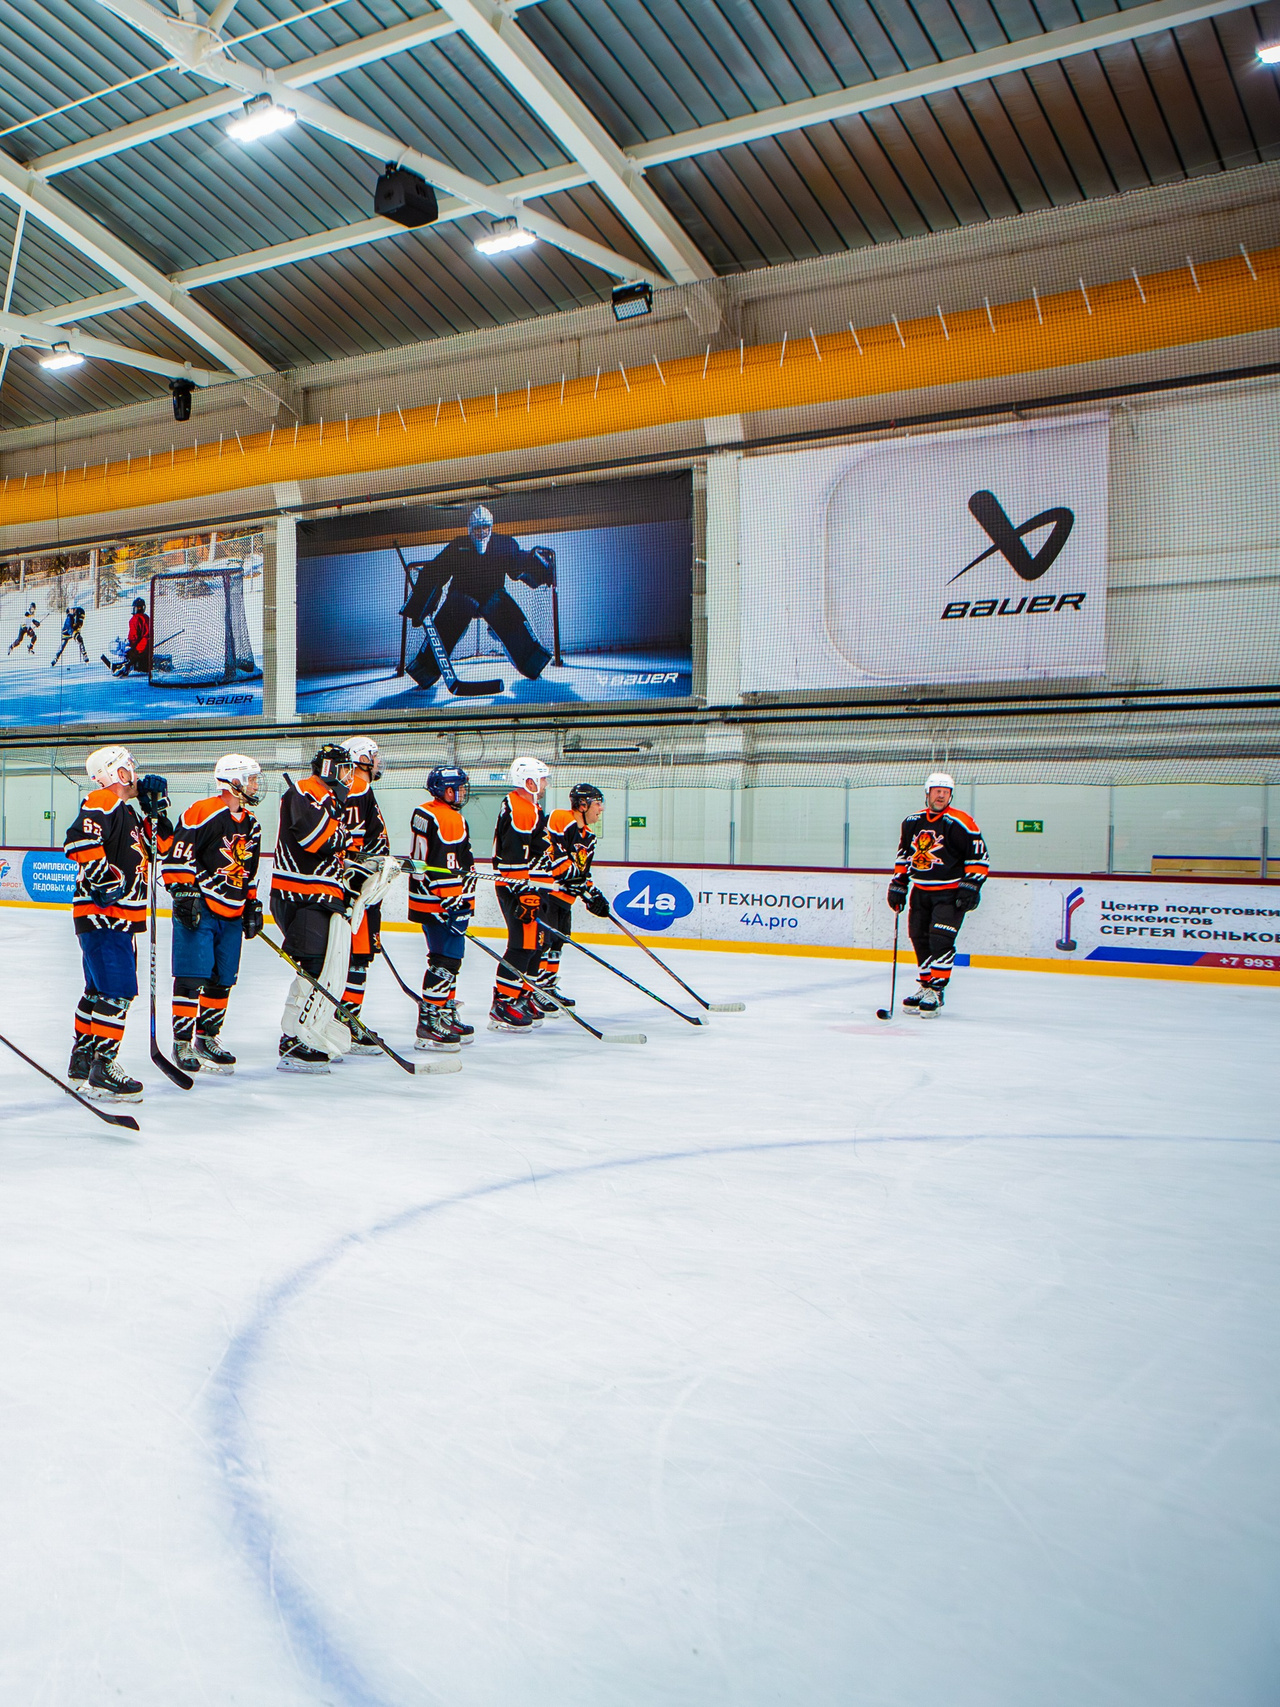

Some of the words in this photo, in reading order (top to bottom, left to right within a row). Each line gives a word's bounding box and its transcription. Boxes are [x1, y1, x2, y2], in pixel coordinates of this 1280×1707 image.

[941, 592, 1087, 620] BAUER
[427, 627, 454, 680] BAUER
[610, 672, 679, 686] BAUER
[206, 695, 254, 706] BAUER
[345, 806, 359, 825] 71
[173, 841, 194, 861] 64
[718, 892, 844, 910] ТЕХНОЛОГИИ
[1101, 900, 1159, 914] Центр
[1165, 905, 1280, 917] подготовки
[740, 912, 798, 930] 4A.pro
[1100, 913, 1213, 925] хоккеистов
[1100, 925, 1175, 938] СЕРГЕЯ
[1220, 957, 1239, 966] +7
[1244, 958, 1274, 968] 993
